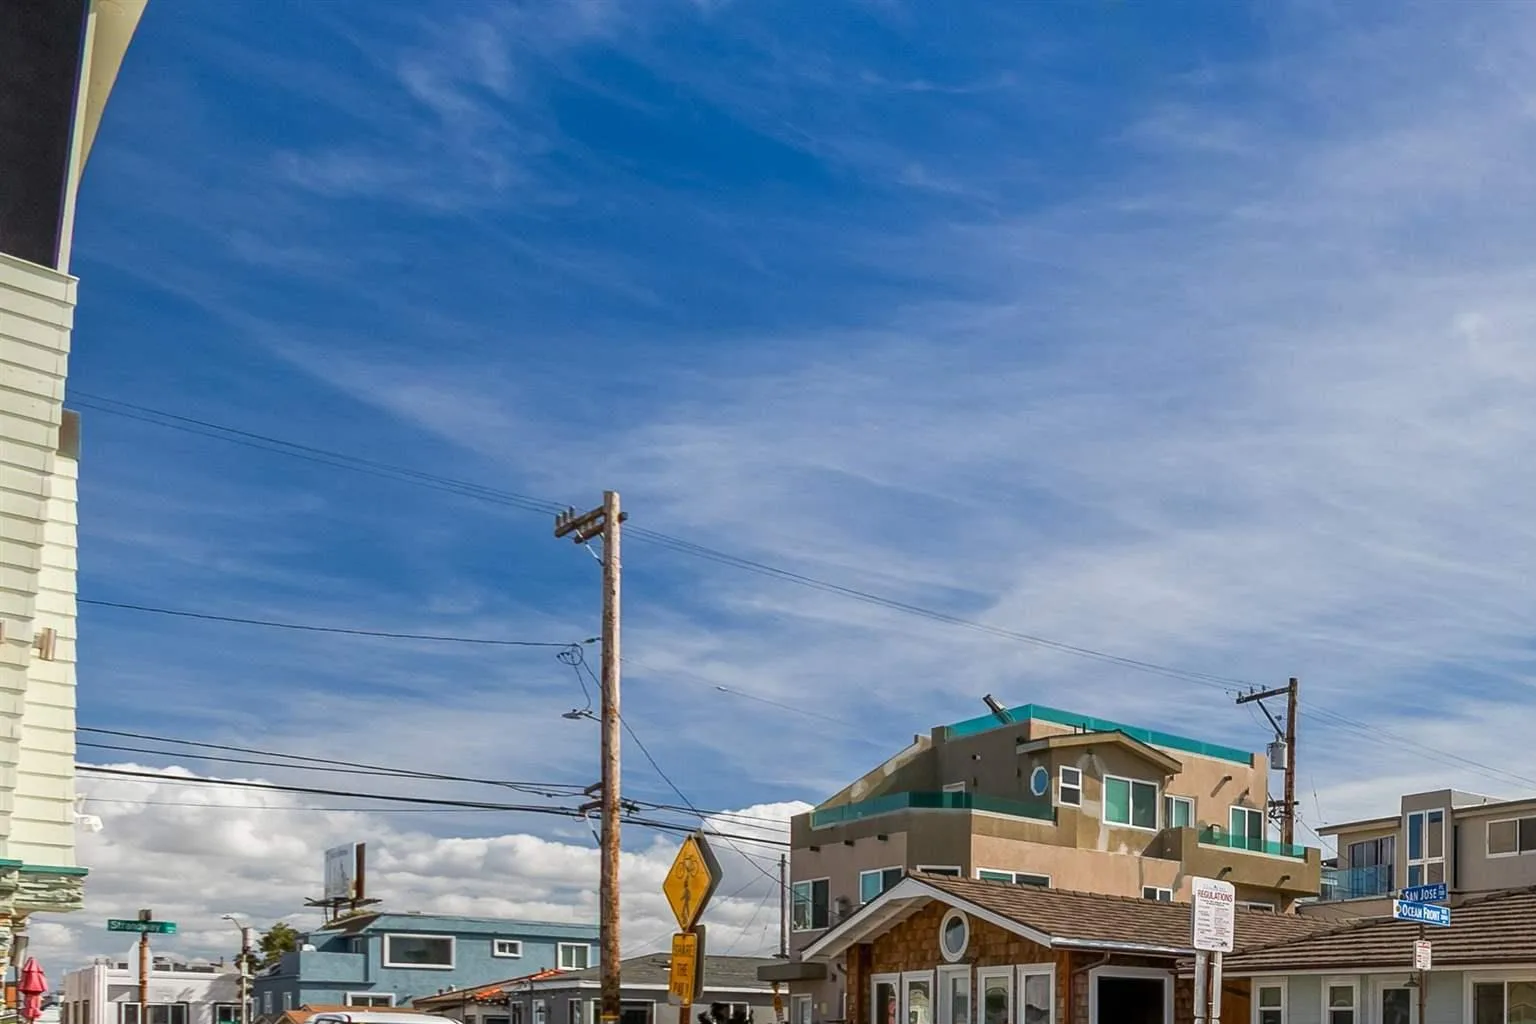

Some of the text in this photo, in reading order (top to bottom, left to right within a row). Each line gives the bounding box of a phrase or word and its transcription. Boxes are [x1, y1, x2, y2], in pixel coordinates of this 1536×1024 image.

[1197, 889, 1233, 903] REGULATIONS
[1405, 890, 1419, 901] SAN
[1420, 888, 1437, 900] JOSE
[1424, 907, 1440, 920] FRONT
